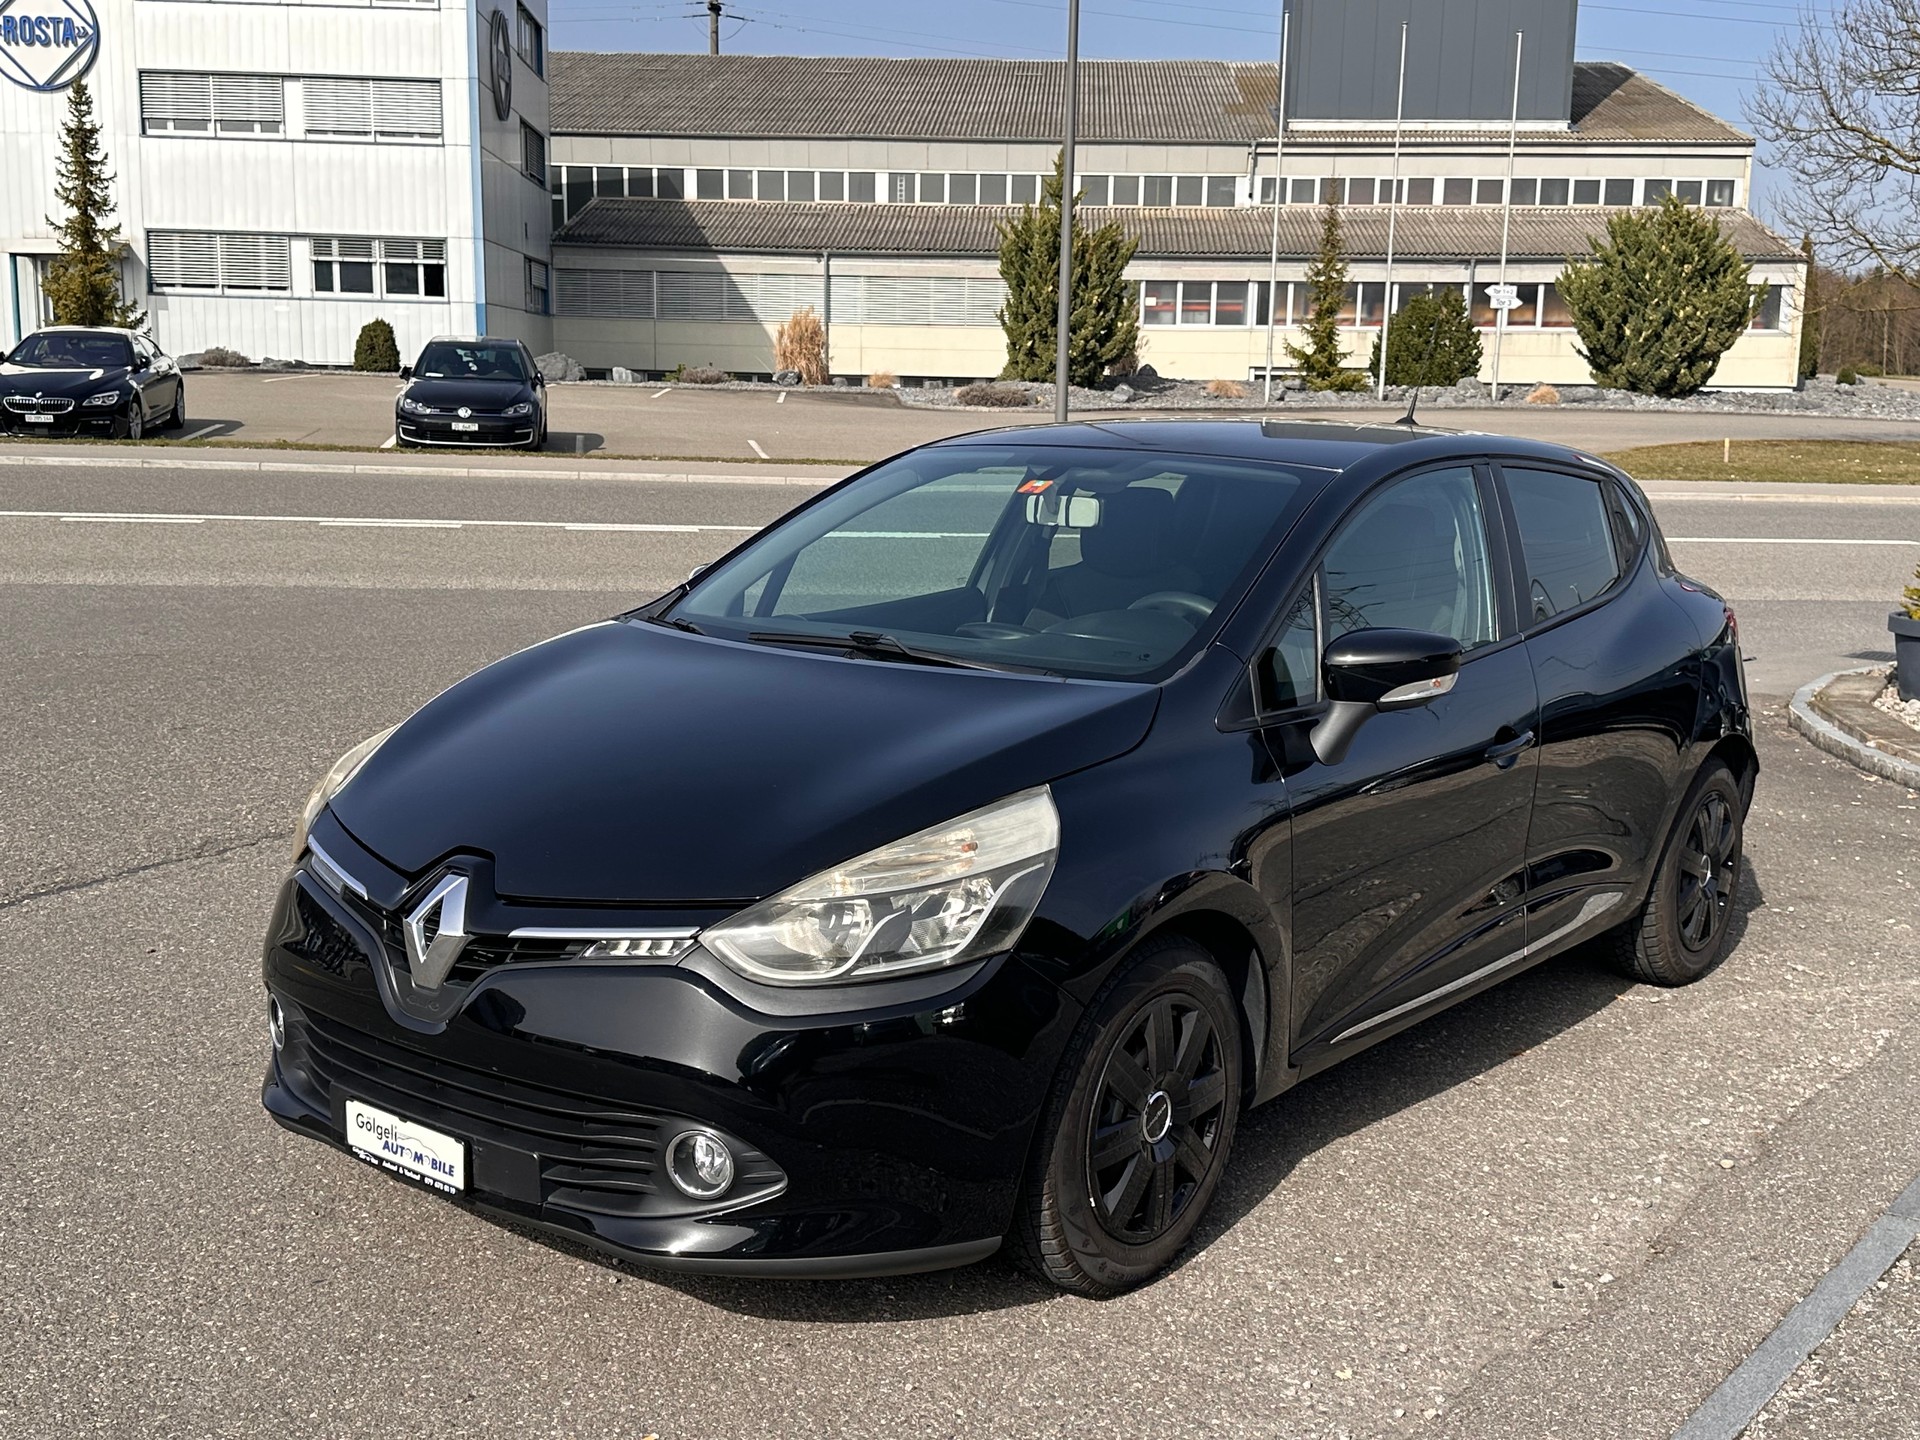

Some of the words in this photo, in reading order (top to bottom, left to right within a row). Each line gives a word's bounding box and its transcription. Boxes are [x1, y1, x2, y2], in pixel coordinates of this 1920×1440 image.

[1495, 298, 1506, 306] Tor
[355, 1113, 398, 1142] Gölgeli
[382, 1140, 455, 1177] AUTOMOBILE
